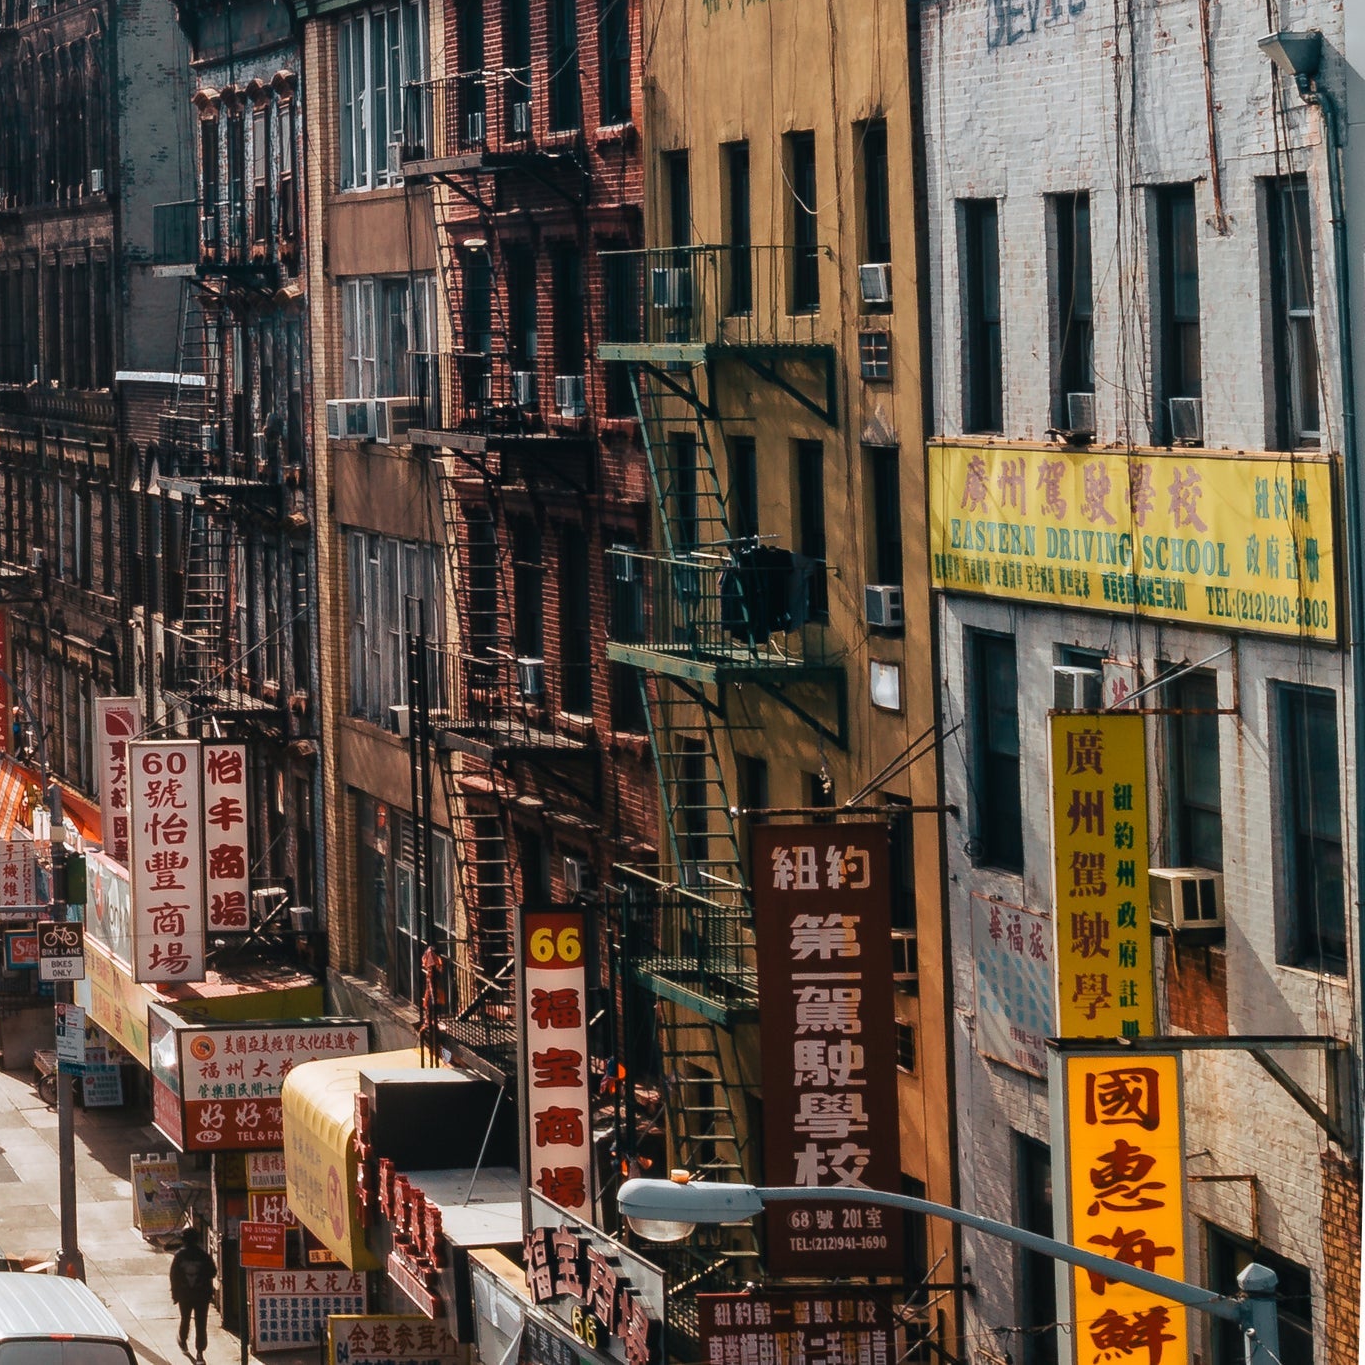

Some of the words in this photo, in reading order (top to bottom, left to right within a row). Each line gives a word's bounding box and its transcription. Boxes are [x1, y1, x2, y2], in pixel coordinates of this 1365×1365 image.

[961, 455, 1208, 533] 廣州駕駛學校
[951, 518, 1037, 557] EASTERN
[1046, 526, 1133, 567] DRIVING
[1143, 534, 1231, 577] SCHOOL
[771, 845, 871, 891] 紐約
[1066, 728, 1112, 1021] 廣州駕駛學
[16, 939, 38, 956] Sig
[530, 927, 581, 963] 66
[989, 906, 1053, 961] 華福旅
[51, 960, 73, 969] BIKES
[62, 947, 81, 955] LANE
[52, 969, 72, 977] ONLY
[790, 913, 871, 1189] 第一駕駛學校
[237, 1131, 255, 1141] TEL
[257, 1132, 265, 1141] &
[842, 1208, 883, 1230] 201室
[1085, 1067, 1177, 1365] 國惠海鮮
[789, 1235, 887, 1251] TEL:(212)941-1690
[258, 1273, 362, 1292] 福州大花店
